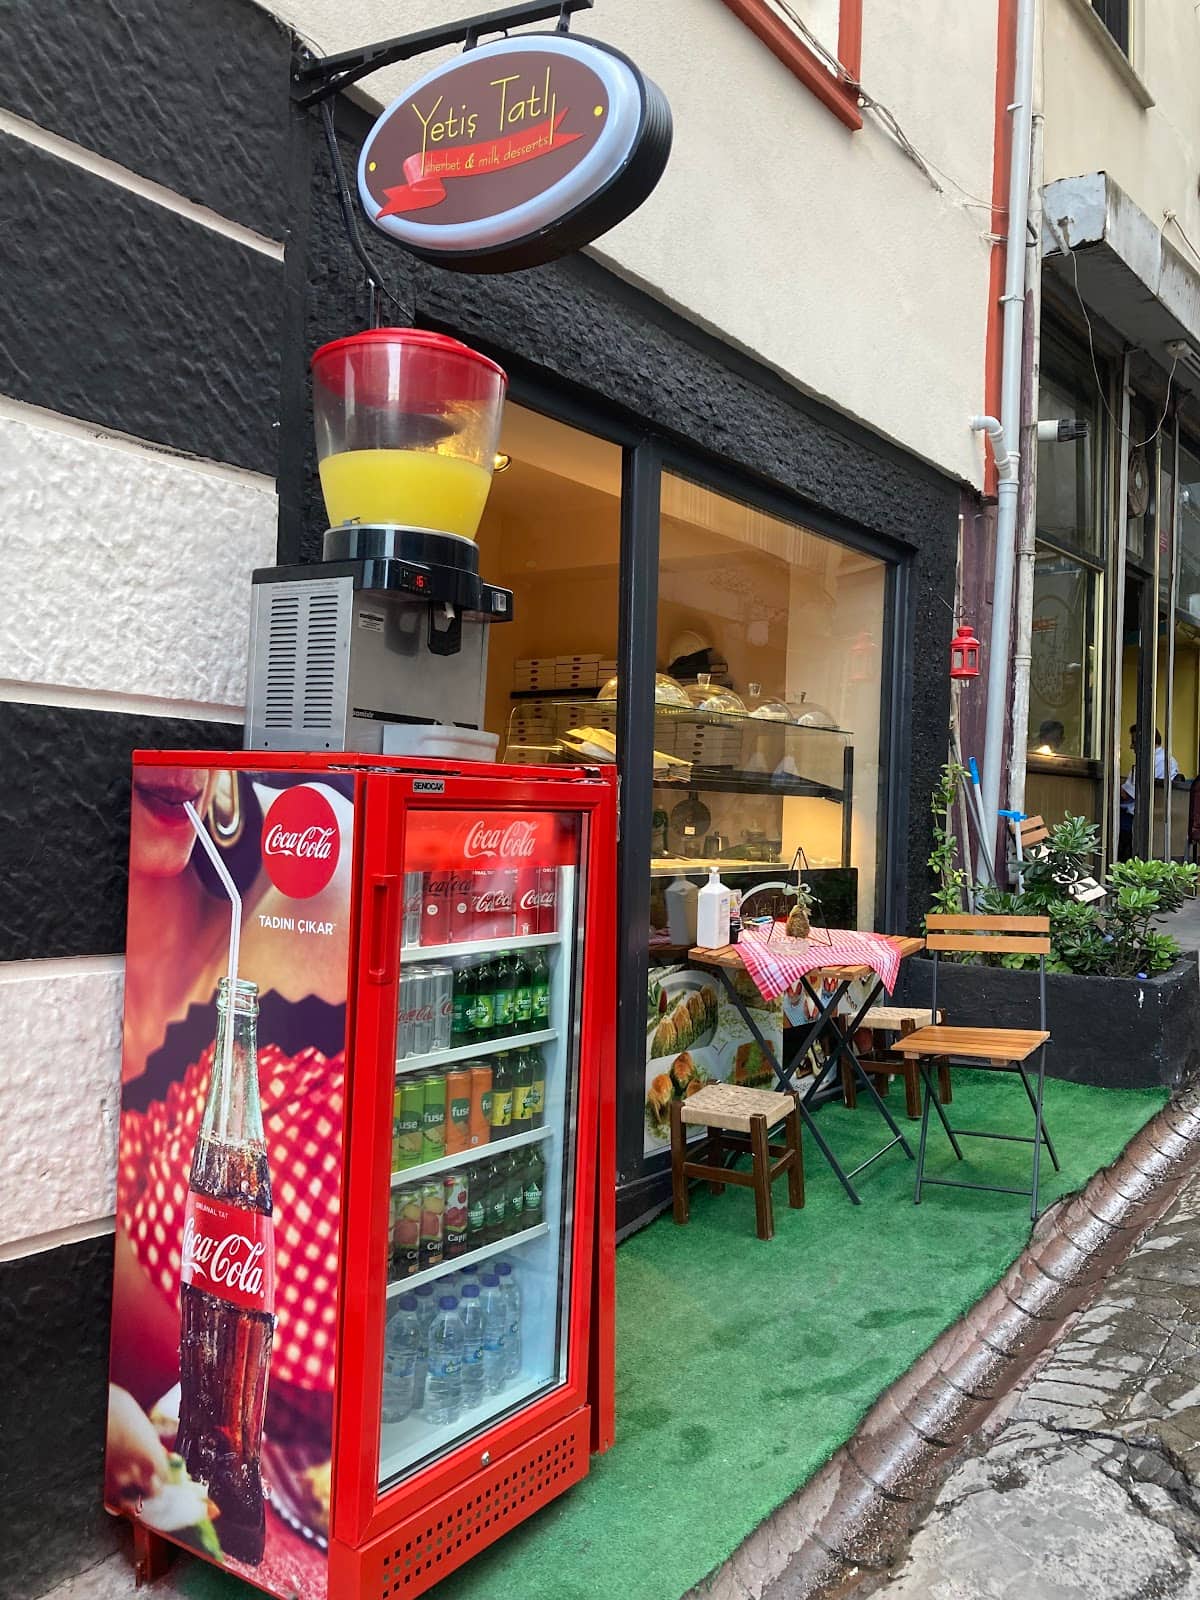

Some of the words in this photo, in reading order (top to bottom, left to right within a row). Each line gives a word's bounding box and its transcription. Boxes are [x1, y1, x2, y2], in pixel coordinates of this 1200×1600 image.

[411, 95, 478, 177] Yetiş
[490, 66, 556, 144] Tatlı
[465, 152, 475, 169] &
[479, 145, 500, 167] milk
[503, 136, 549, 161] desserts
[264, 823, 336, 860] Coca-Cola
[463, 820, 540, 859] Coca-Cola
[259, 914, 295, 931] TADINI
[297, 919, 334, 936] ÇIKAR
